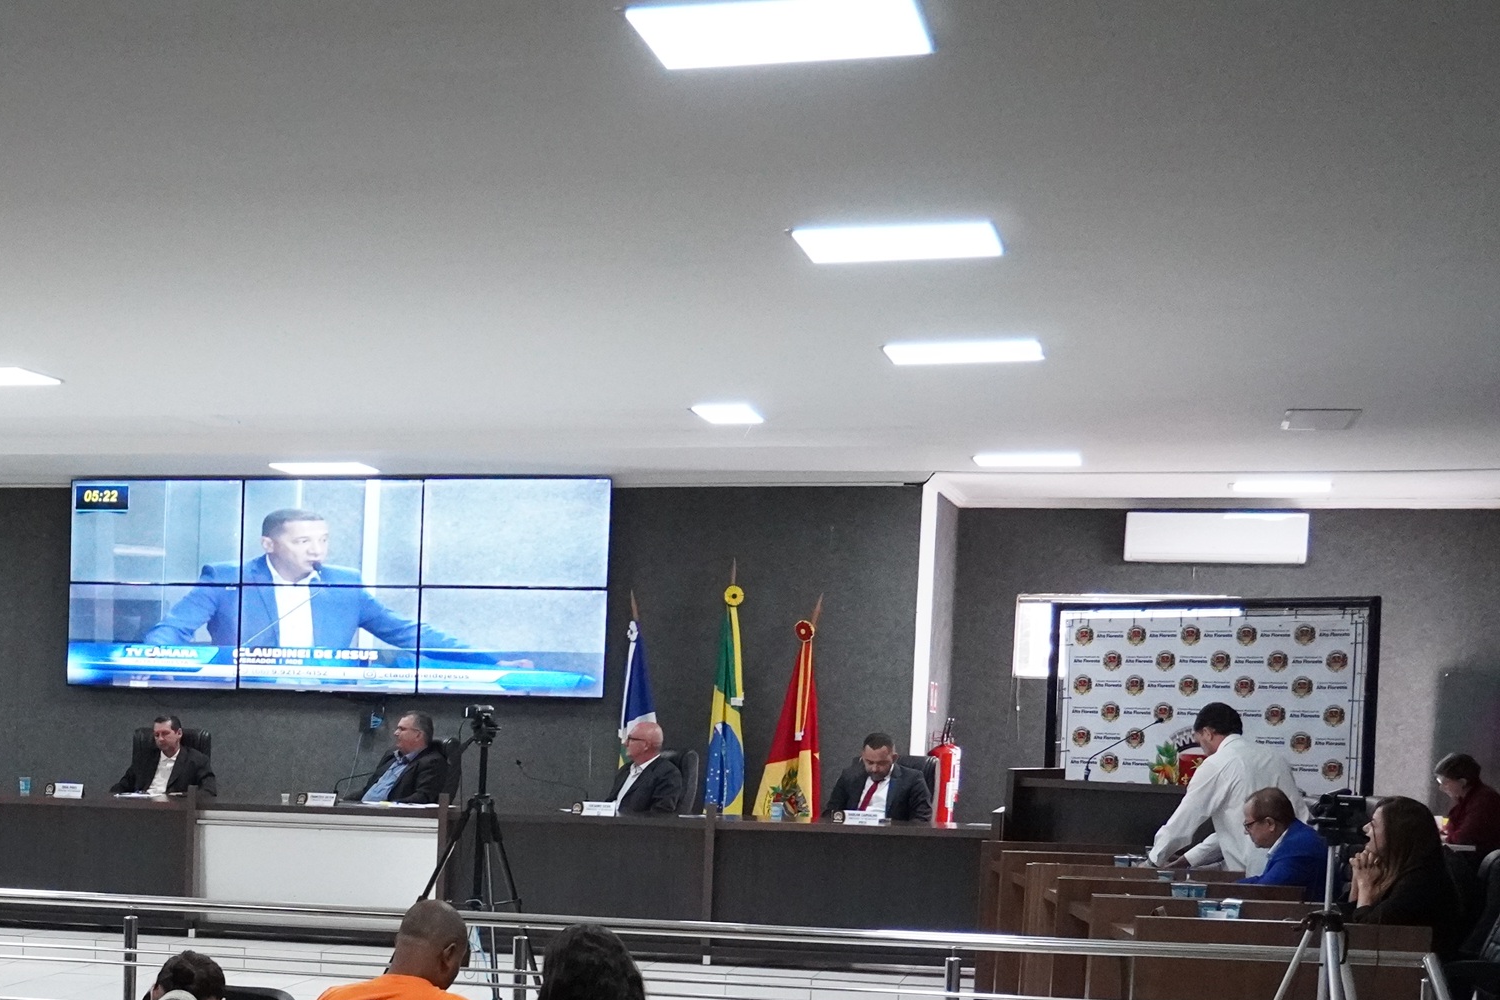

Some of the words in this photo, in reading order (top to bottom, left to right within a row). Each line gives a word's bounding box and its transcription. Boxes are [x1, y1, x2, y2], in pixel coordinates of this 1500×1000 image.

[84, 489, 119, 502] 05:22
[126, 647, 143, 657] TV
[145, 646, 198, 658] CÂMARA
[232, 647, 311, 659] CLAUDINEI
[314, 650, 332, 659] DE
[335, 650, 378, 660] JESUS
